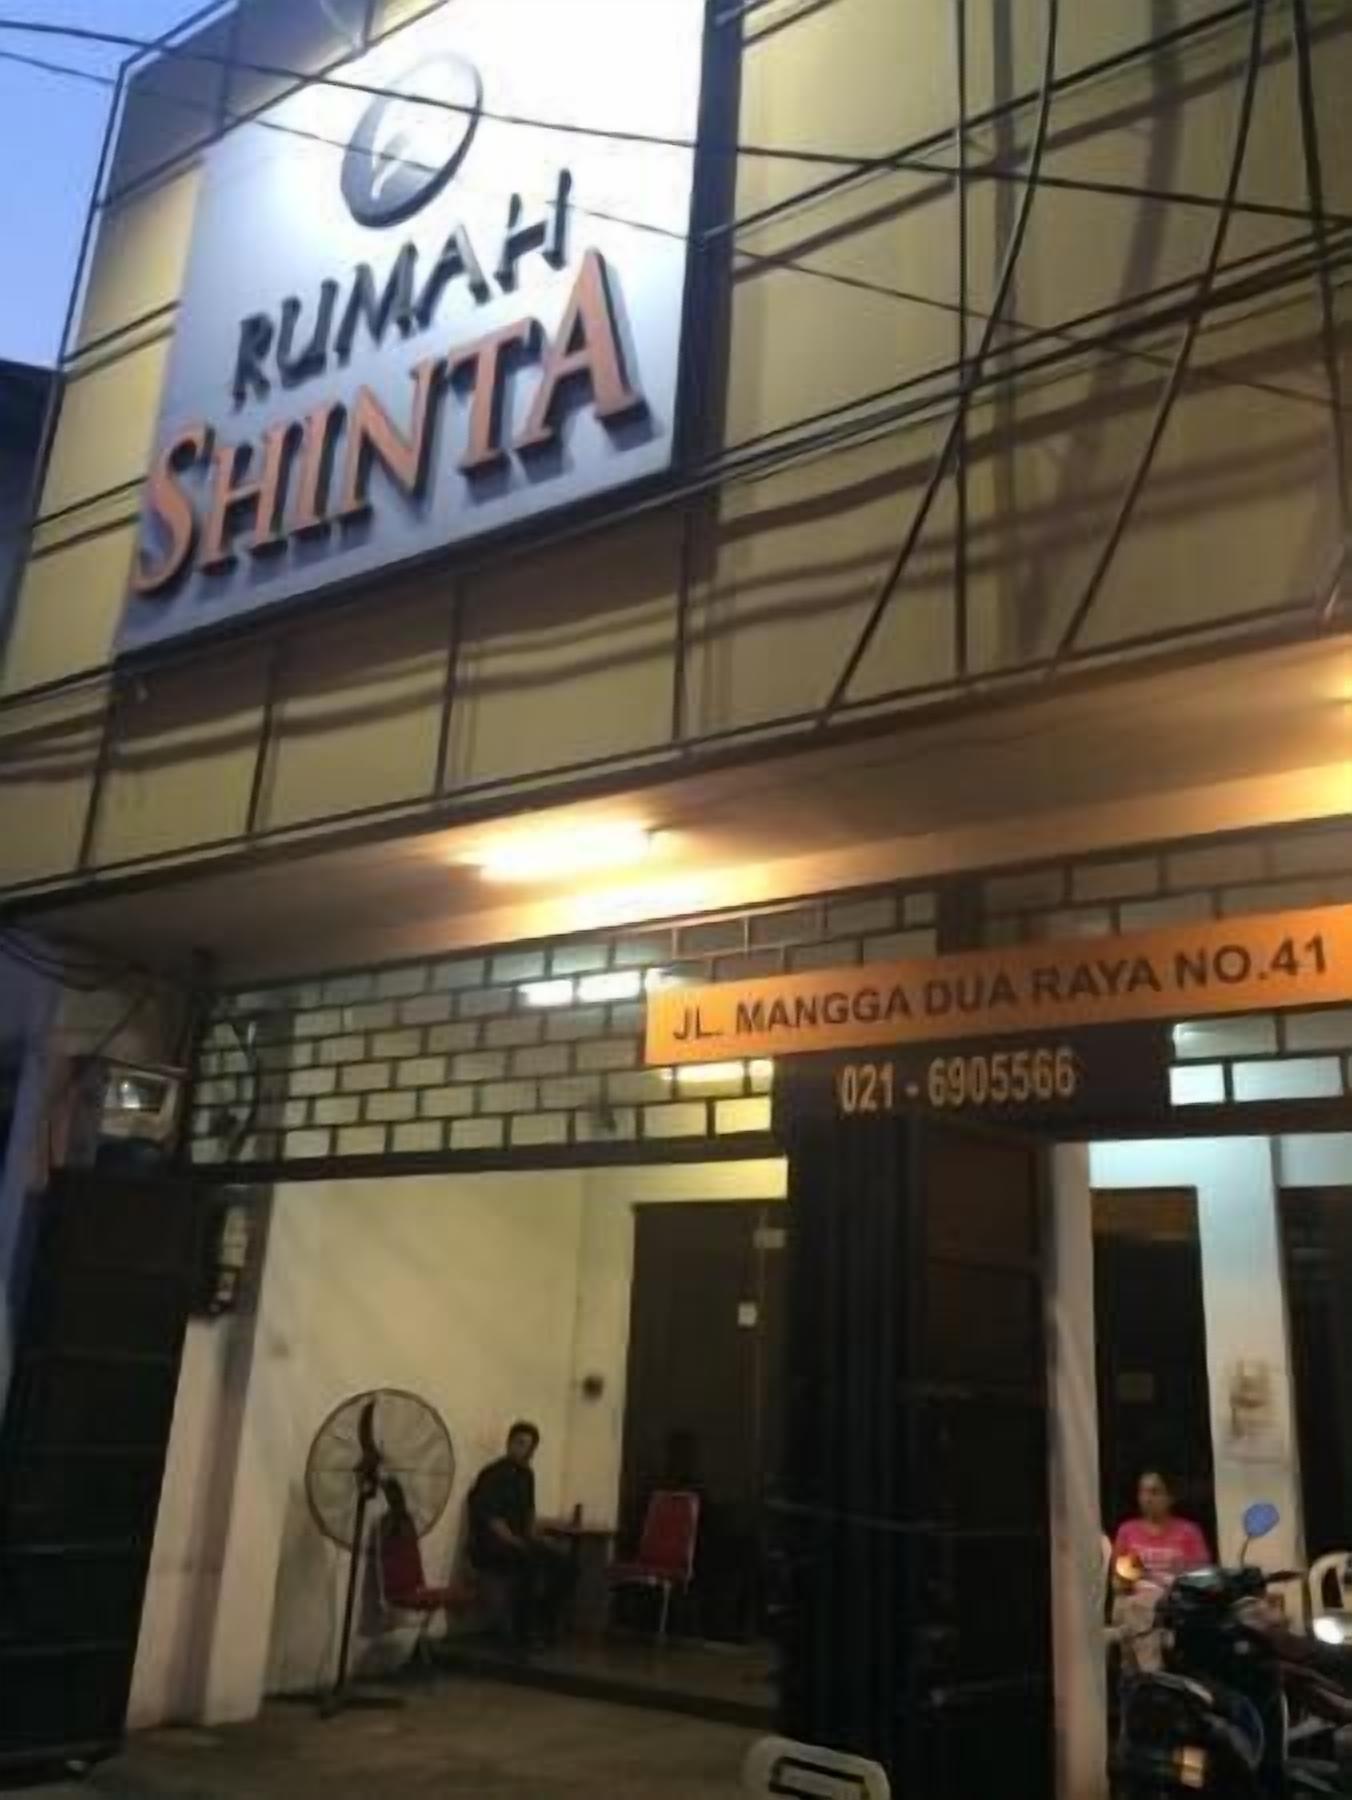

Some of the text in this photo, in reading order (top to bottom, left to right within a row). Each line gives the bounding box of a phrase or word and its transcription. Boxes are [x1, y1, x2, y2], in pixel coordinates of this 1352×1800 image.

[232, 167, 573, 412] RUMAH
[131, 247, 652, 595] SHINTA
[734, 985, 911, 1033] MANGGA
[925, 972, 1023, 1018] DUA
[1031, 956, 1163, 1004] RAYA
[840, 1063, 895, 1113] 021
[927, 1046, 1078, 1107] 6905566
